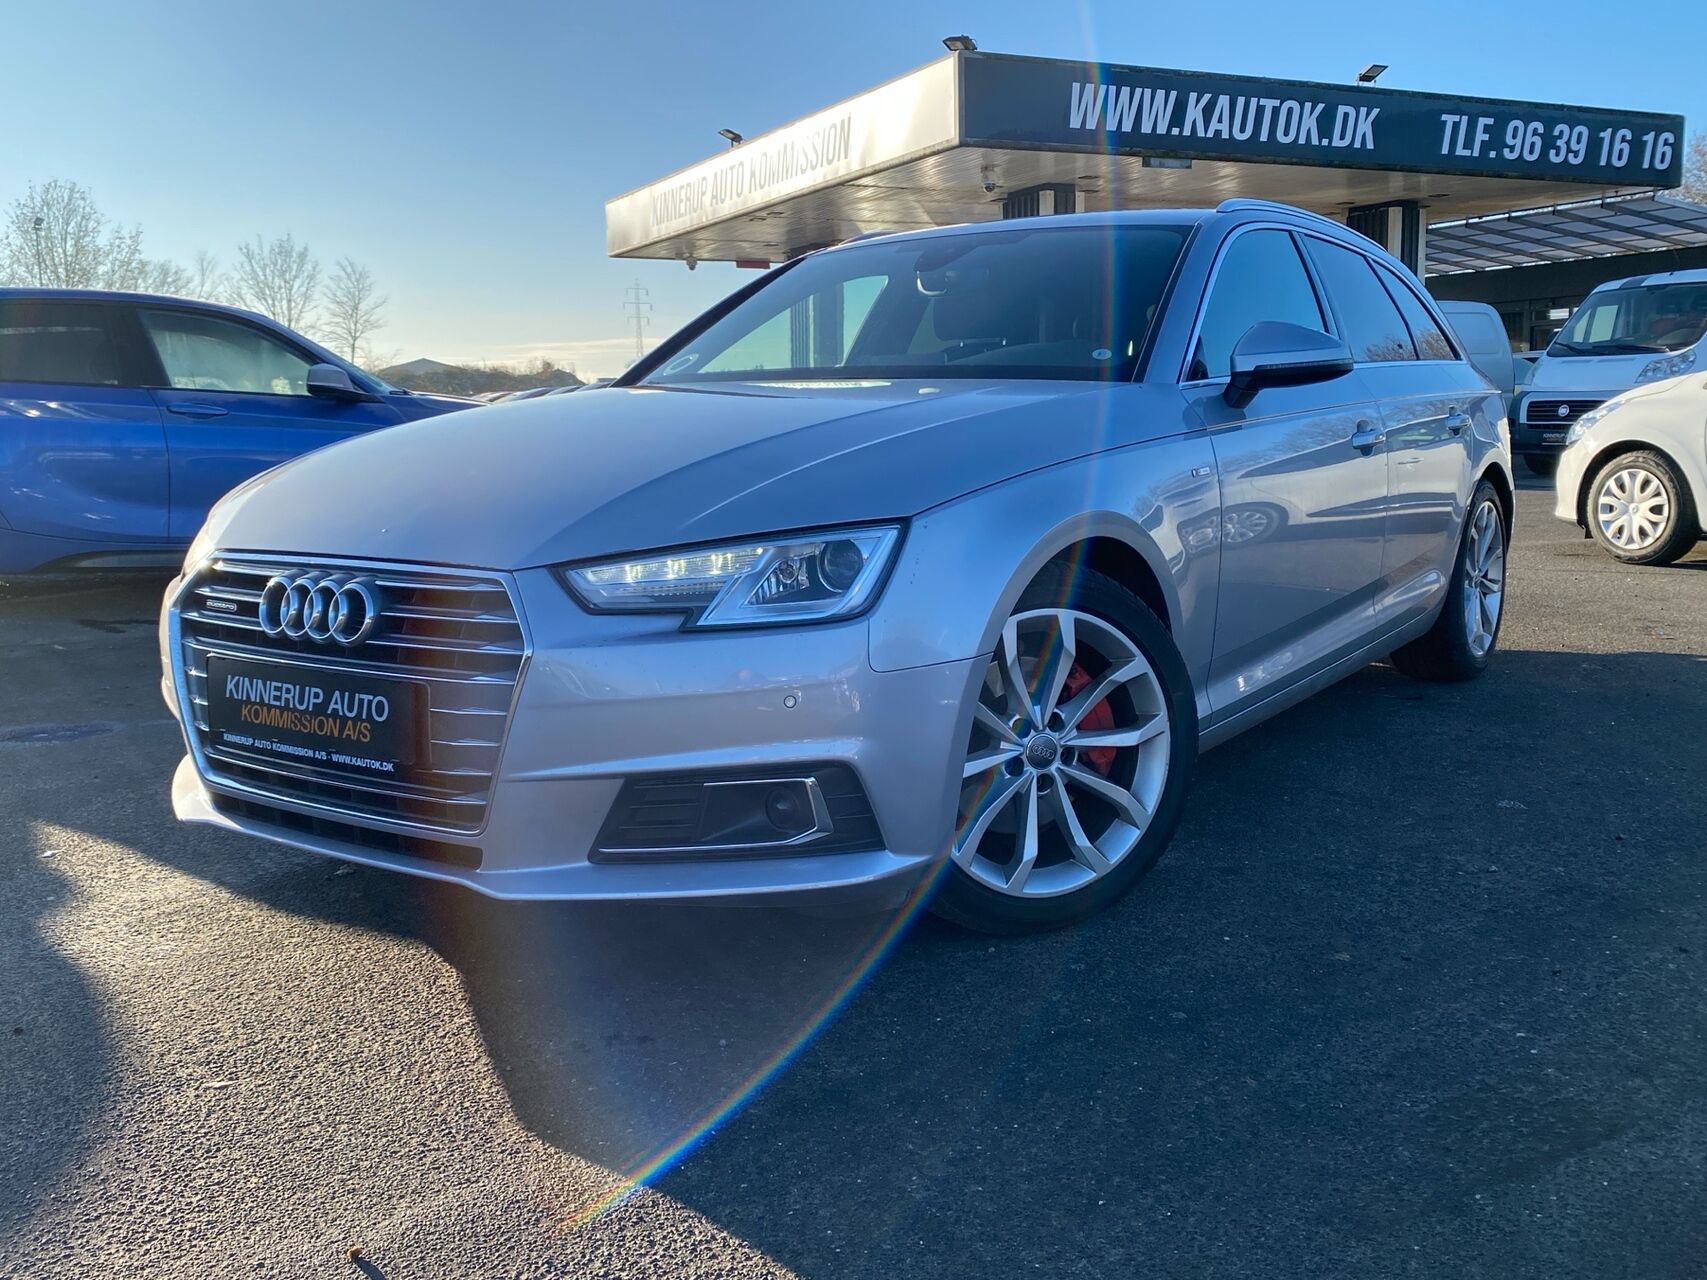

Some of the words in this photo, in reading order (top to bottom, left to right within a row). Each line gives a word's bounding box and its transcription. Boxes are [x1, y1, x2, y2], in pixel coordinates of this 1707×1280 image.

[1069, 82, 1381, 150] WWW.KAUTOK.DK
[1440, 114, 1496, 158] TLF.
[1503, 120, 1545, 162] 96
[1549, 123, 1589, 165] 39
[1599, 127, 1632, 168] 16
[1642, 131, 1675, 170] 16
[652, 176, 708, 226] KINNERUP
[710, 162, 744, 206] AUTO
[749, 112, 851, 193] KOMMISSION
[225, 675, 323, 711] KINNERUP
[328, 690, 389, 722] AUTO
[241, 704, 339, 736] KOMMISSION
[342, 719, 371, 742] A/S
[223, 733, 254, 746] KINNERUP
[254, 739, 271, 749] AUTO
[272, 741, 314, 757] KOMMISSION
[314, 750, 326, 760] A/S
[331, 753, 394, 772] WWW.KAUTOK.DK
